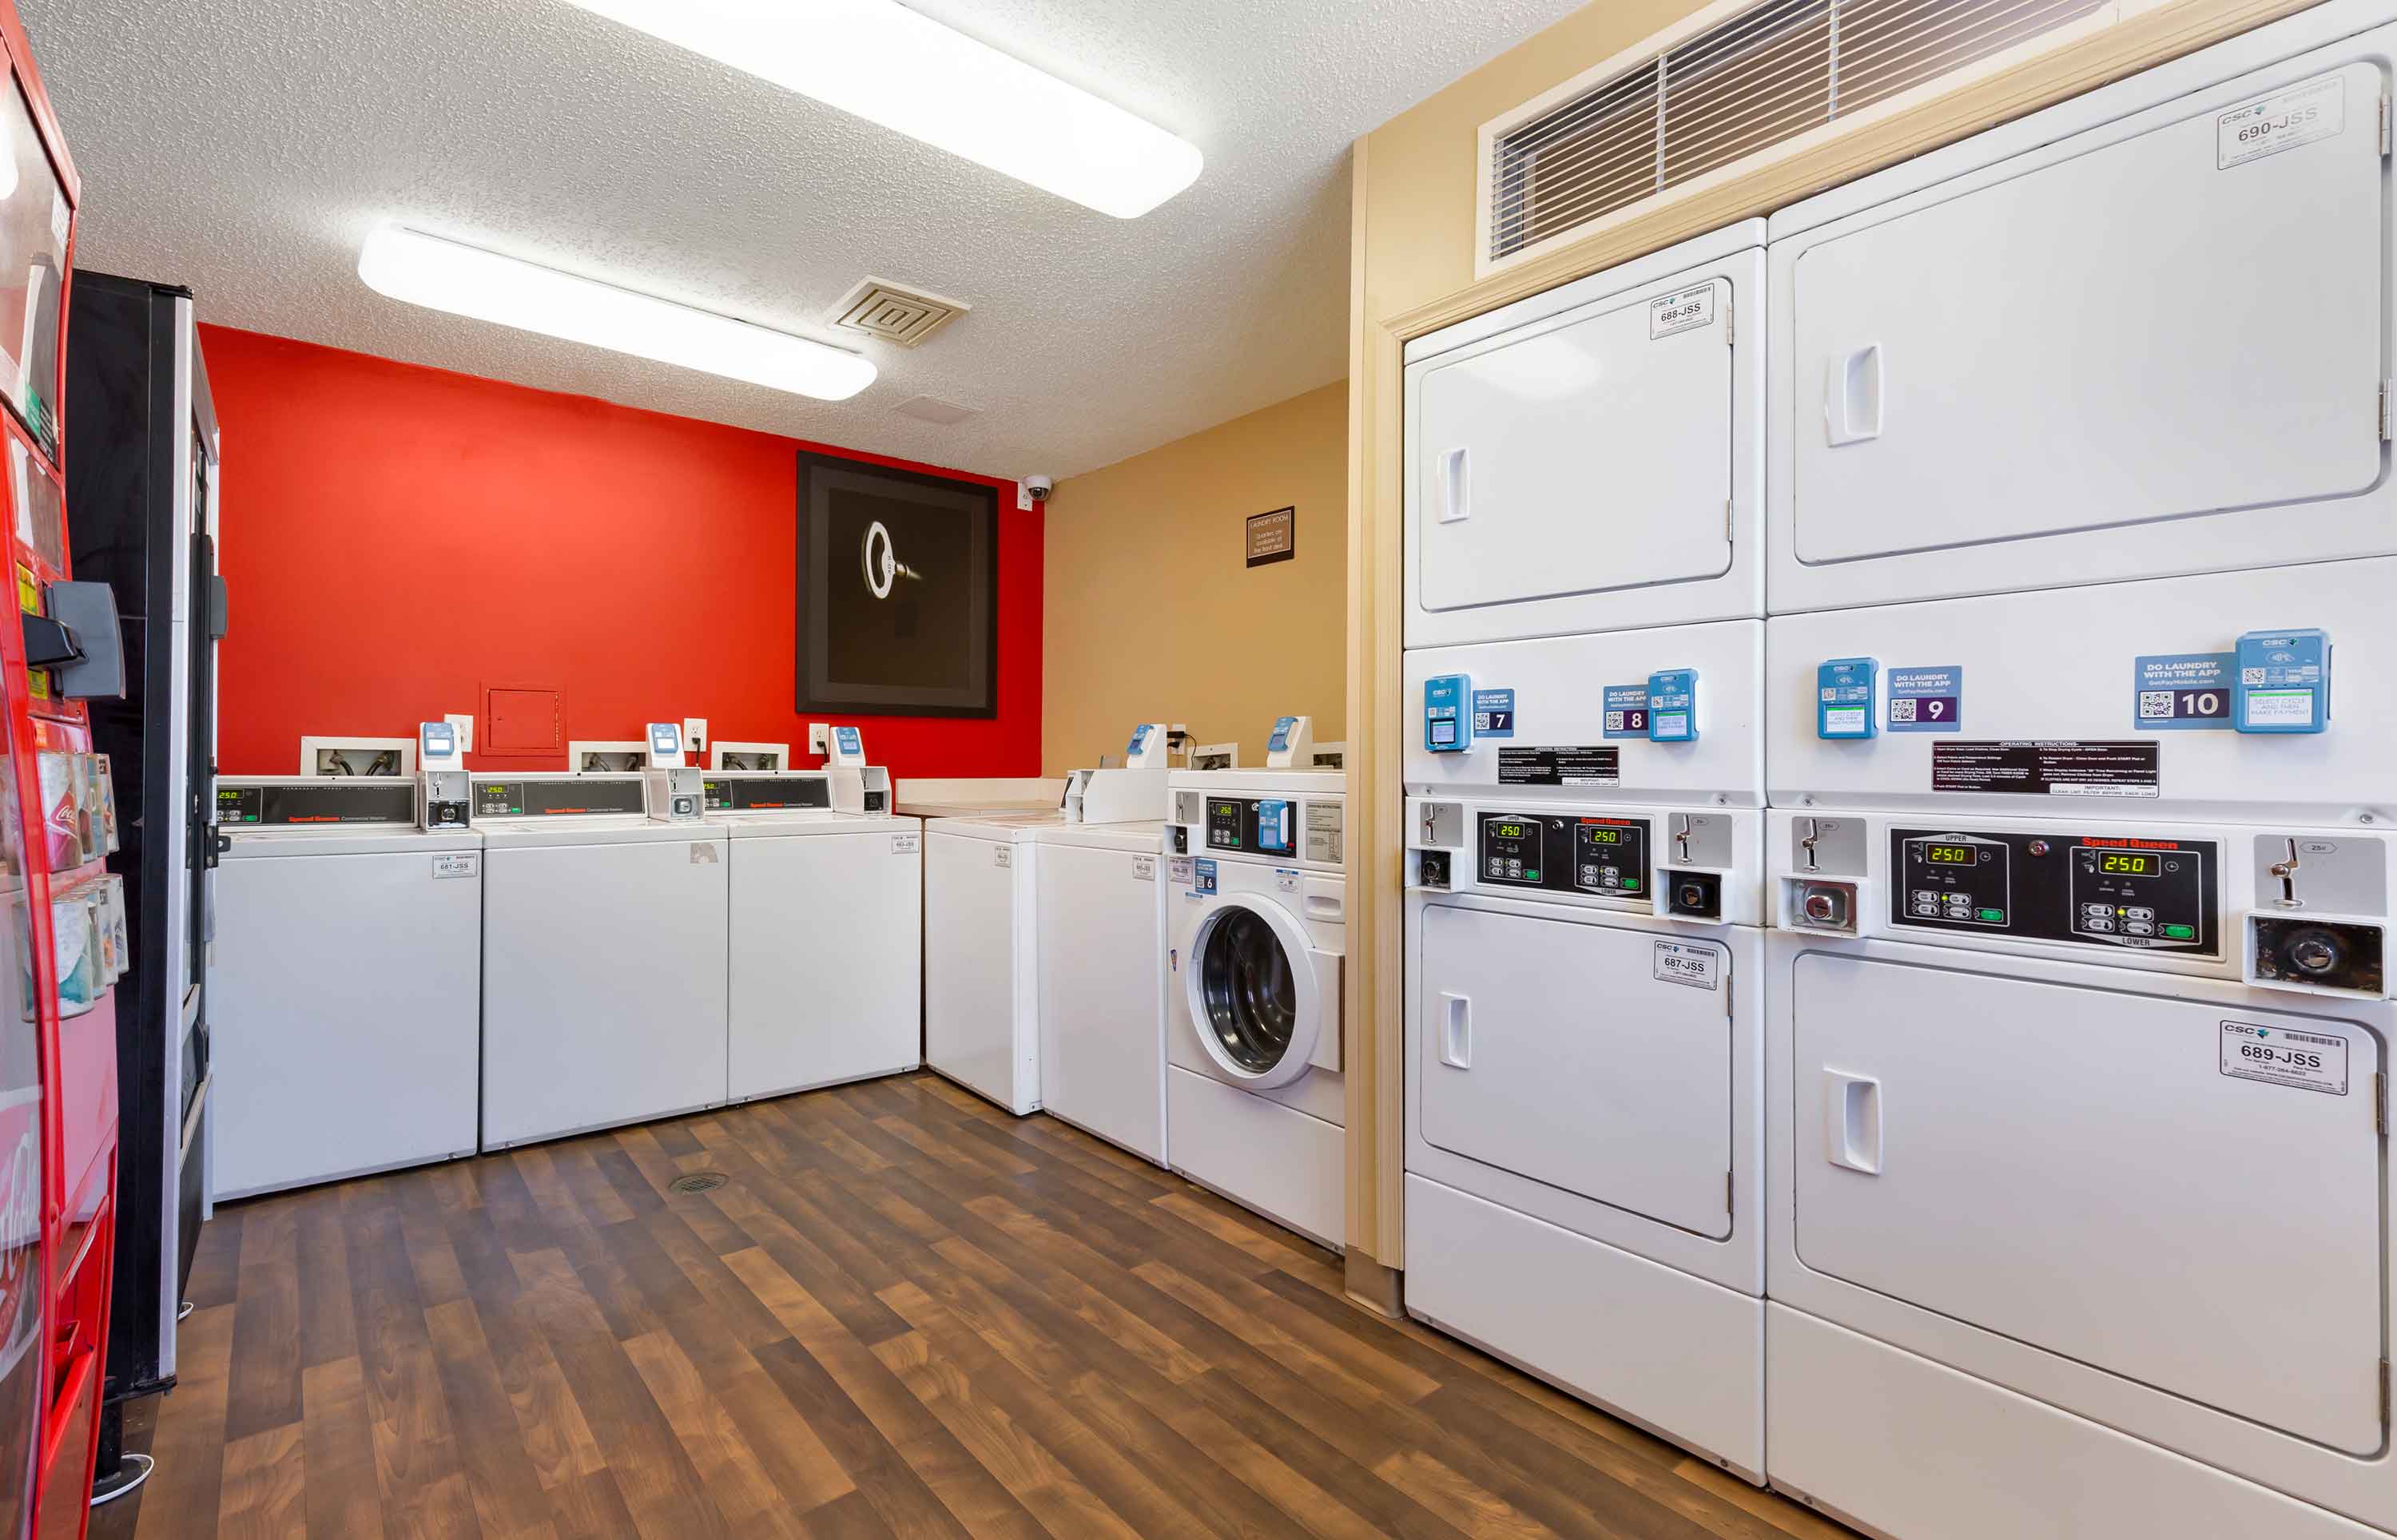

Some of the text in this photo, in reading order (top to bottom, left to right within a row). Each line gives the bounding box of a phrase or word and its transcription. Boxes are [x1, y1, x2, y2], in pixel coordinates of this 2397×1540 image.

[2222, 110, 2252, 125] CSC
[2238, 107, 2317, 141] 690-JSS
[1661, 303, 1701, 322] 688-JSS
[2165, 661, 2217, 670] LAUNDRY
[1928, 701, 1944, 720] 9
[2182, 693, 2219, 715] 10
[1496, 714, 1505, 728] 7
[1632, 712, 1642, 728] 8
[1220, 806, 1232, 815] 250
[1501, 825, 1520, 836] 250
[1595, 831, 1616, 842] 250
[2082, 837, 2178, 850] Speed Queen
[1932, 847, 1965, 862] 250
[2105, 856, 2145, 872] 250
[1206, 878, 1213, 888] 6
[2122, 937, 2150, 947] LOWER
[1664, 958, 1704, 972] 687-JSS
[2224, 1025, 2255, 1034] CSC
[2241, 1045, 2321, 1068] 689-JSS
